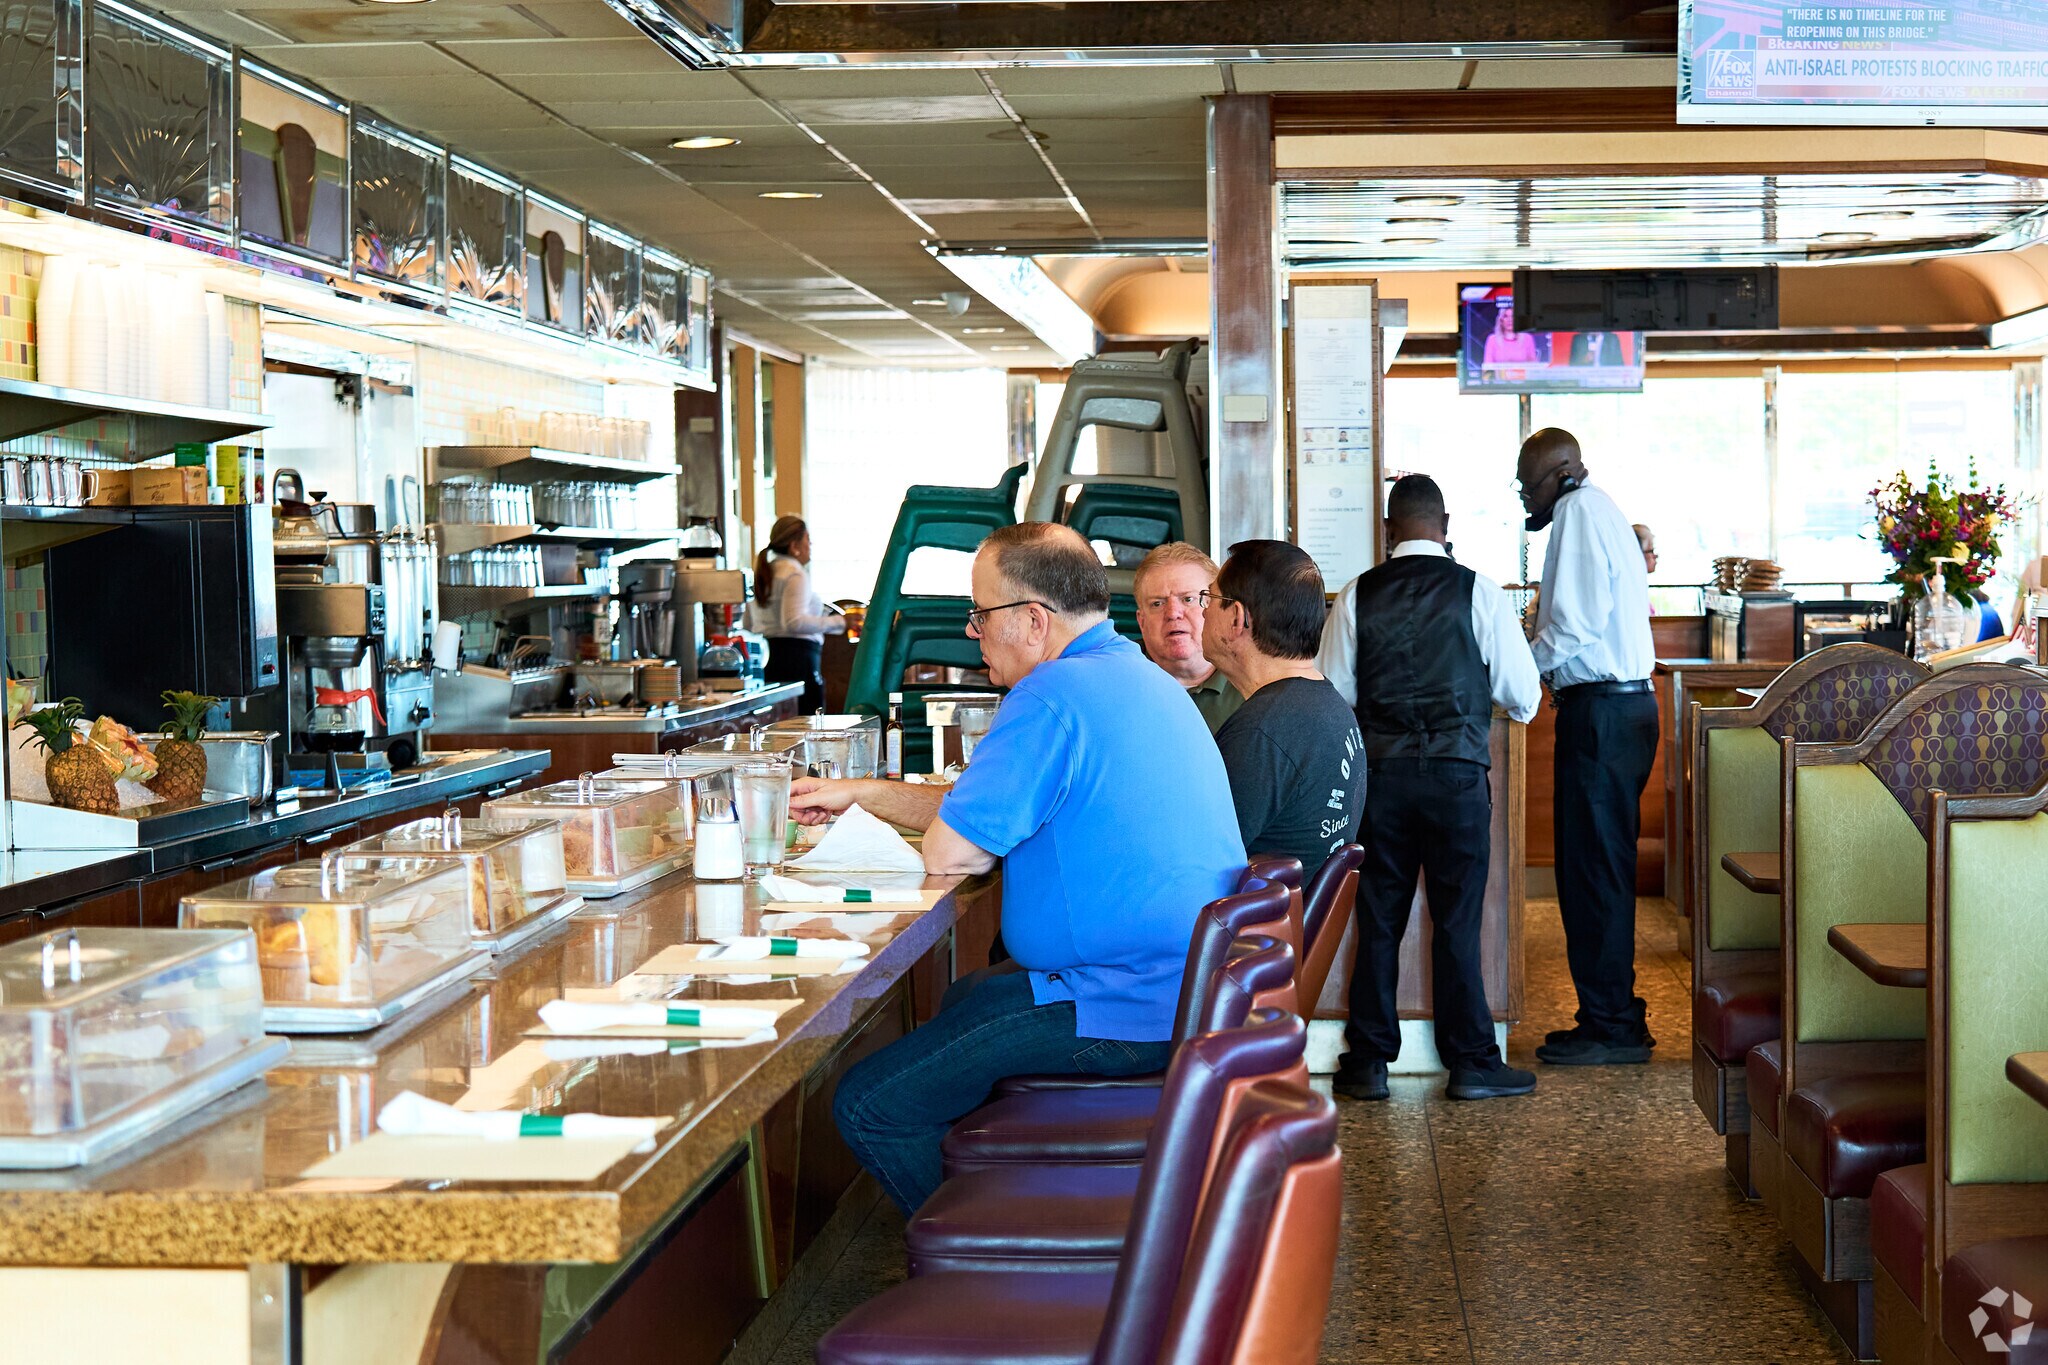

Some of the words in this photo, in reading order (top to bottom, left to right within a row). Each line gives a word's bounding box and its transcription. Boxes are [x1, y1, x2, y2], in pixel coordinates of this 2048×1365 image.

[1787, 9, 1823, 21] "THERE
[1826, 9, 1837, 21] IS
[1839, 9, 1853, 21] NO
[1856, 9, 1903, 21] TIMELINE
[1905, 9, 1925, 21] FOR
[1927, 9, 1947, 22] THE
[1786, 26, 1843, 38] REOPENING
[1846, 26, 1859, 38] ON
[1862, 26, 1885, 38] THIS
[1887, 26, 1934, 39] BRIDGE."
[1767, 38, 1840, 50] BREAKING
[1722, 61, 1752, 75] FOX
[1764, 59, 1848, 77] ANTI-ISRAEL
[1851, 59, 1917, 77] PROTESTS
[1921, 59, 1993, 77] BLOCKING
[1714, 75, 1752, 88] NEWS
[1708, 89, 1752, 97] channel
[1891, 86, 1921, 98] FOX
[1924, 86, 1966, 98] NEWS
[1969, 86, 2026, 98] ALERT
[1320, 814, 1349, 838] Since
